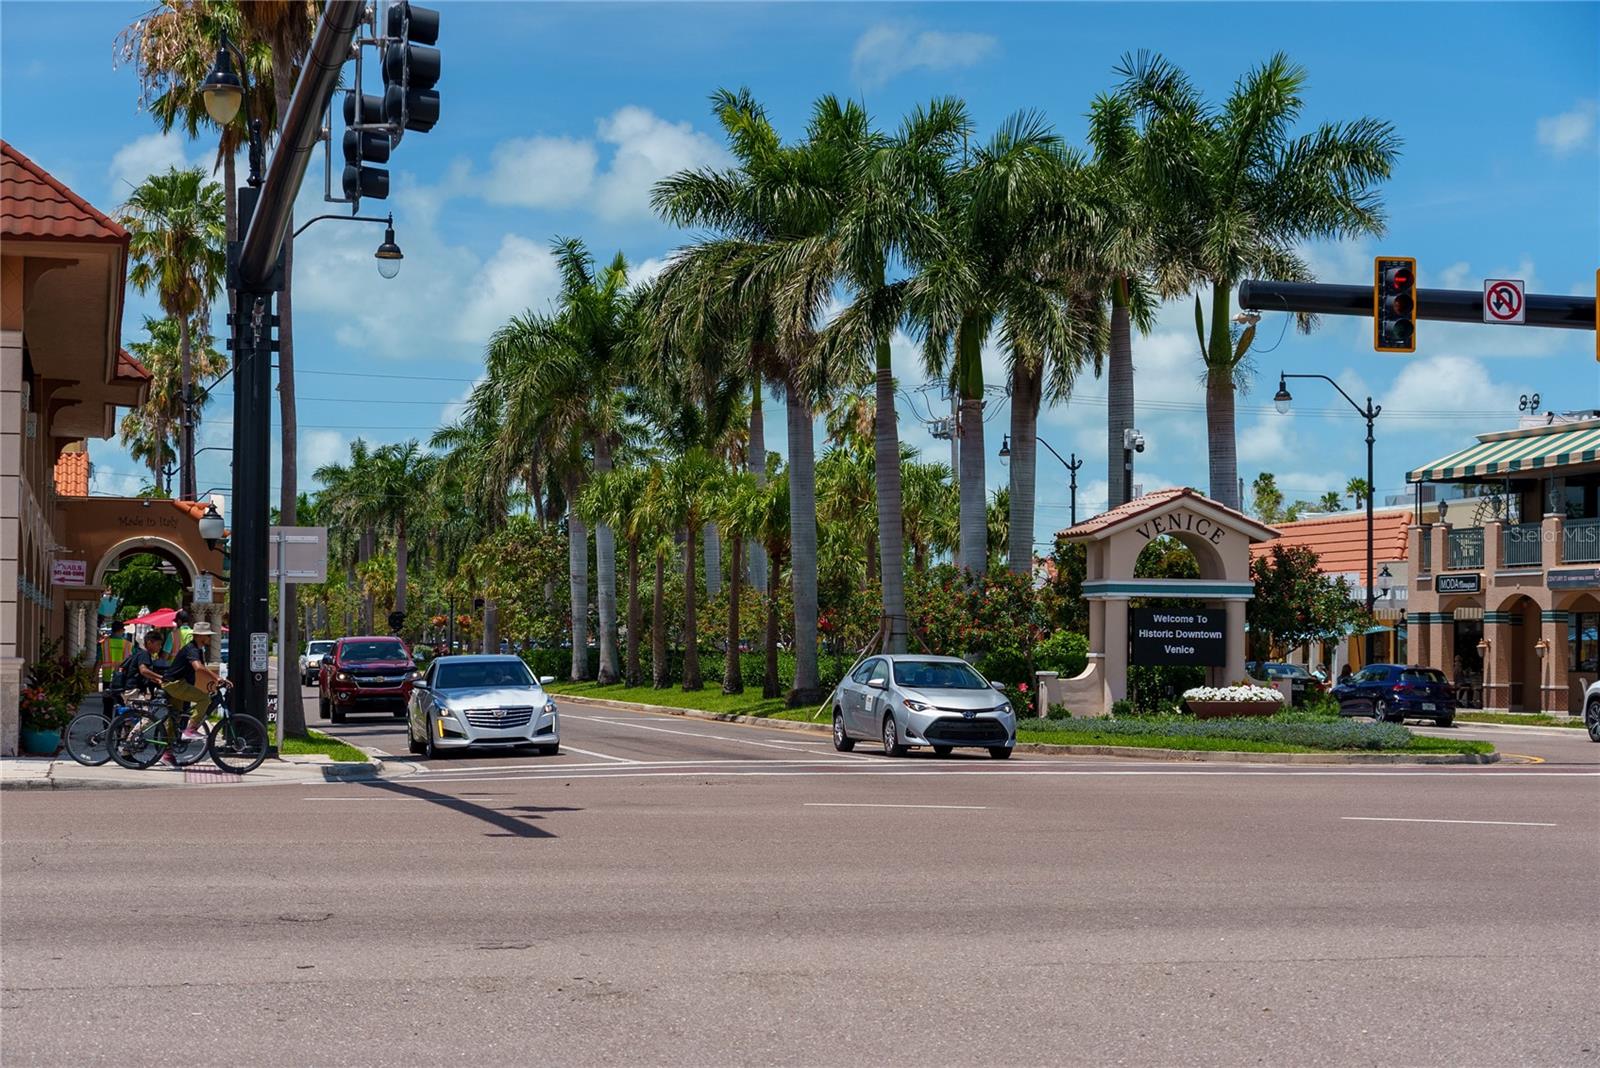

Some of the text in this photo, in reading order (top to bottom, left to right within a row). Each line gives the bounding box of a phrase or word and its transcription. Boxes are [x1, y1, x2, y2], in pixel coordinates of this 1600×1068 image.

[118, 515, 144, 528] Made
[159, 515, 178, 530] Italy
[1136, 513, 1226, 545] VENICE
[1440, 578, 1459, 590] MODA
[1153, 614, 1208, 624] Welcome To
[1138, 629, 1223, 640] Historic Downtown
[1164, 644, 1195, 654] Venice
